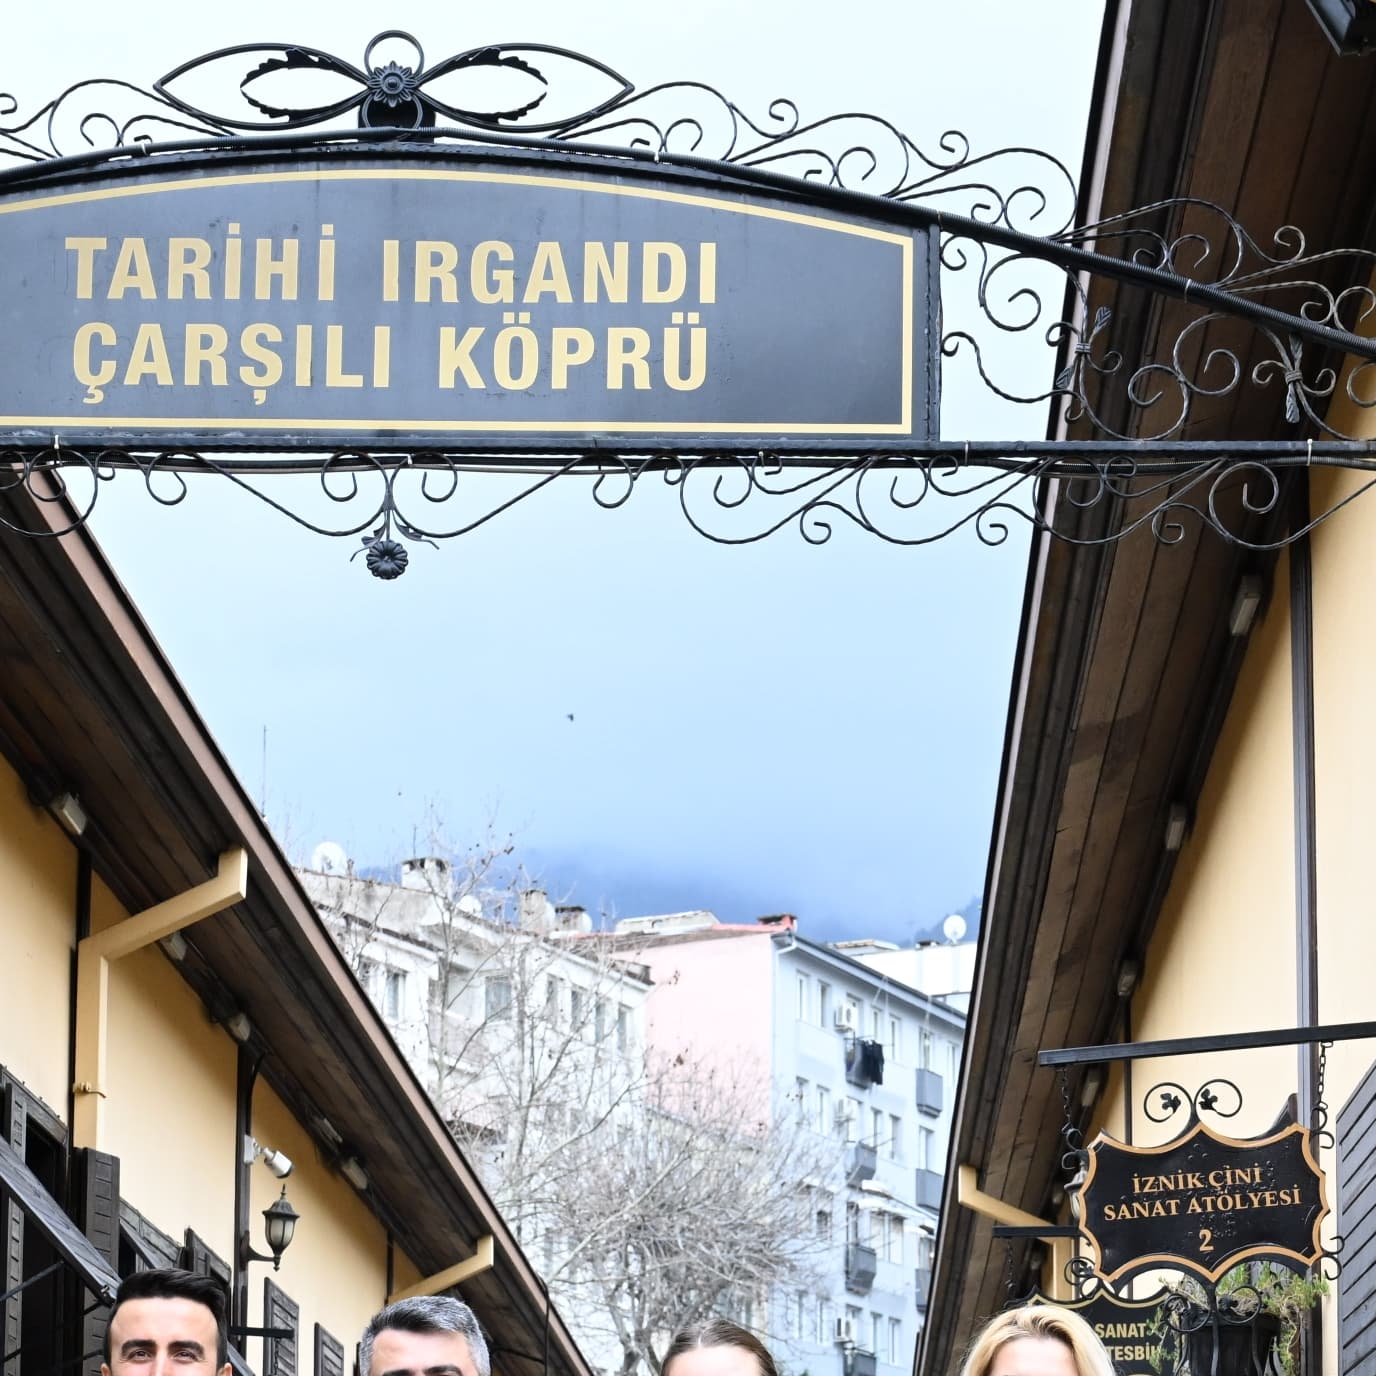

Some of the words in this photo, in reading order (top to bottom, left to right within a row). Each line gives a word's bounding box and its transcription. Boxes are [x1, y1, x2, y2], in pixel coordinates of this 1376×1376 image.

[65, 222, 335, 301] TARİHİ
[383, 239, 716, 304] IRGANDI
[73, 321, 390, 405] ÇARŞILI
[439, 312, 708, 391] KÖPRÜ
[1132, 1169, 1204, 1194] İZNİK
[1208, 1162, 1262, 1191] ÇİNİ
[1103, 1199, 1181, 1221] SANAT
[1186, 1184, 1304, 1215] ATÖLYESİ
[1199, 1228, 1215, 1252] 2
[1094, 1322, 1147, 1339] SANAT
